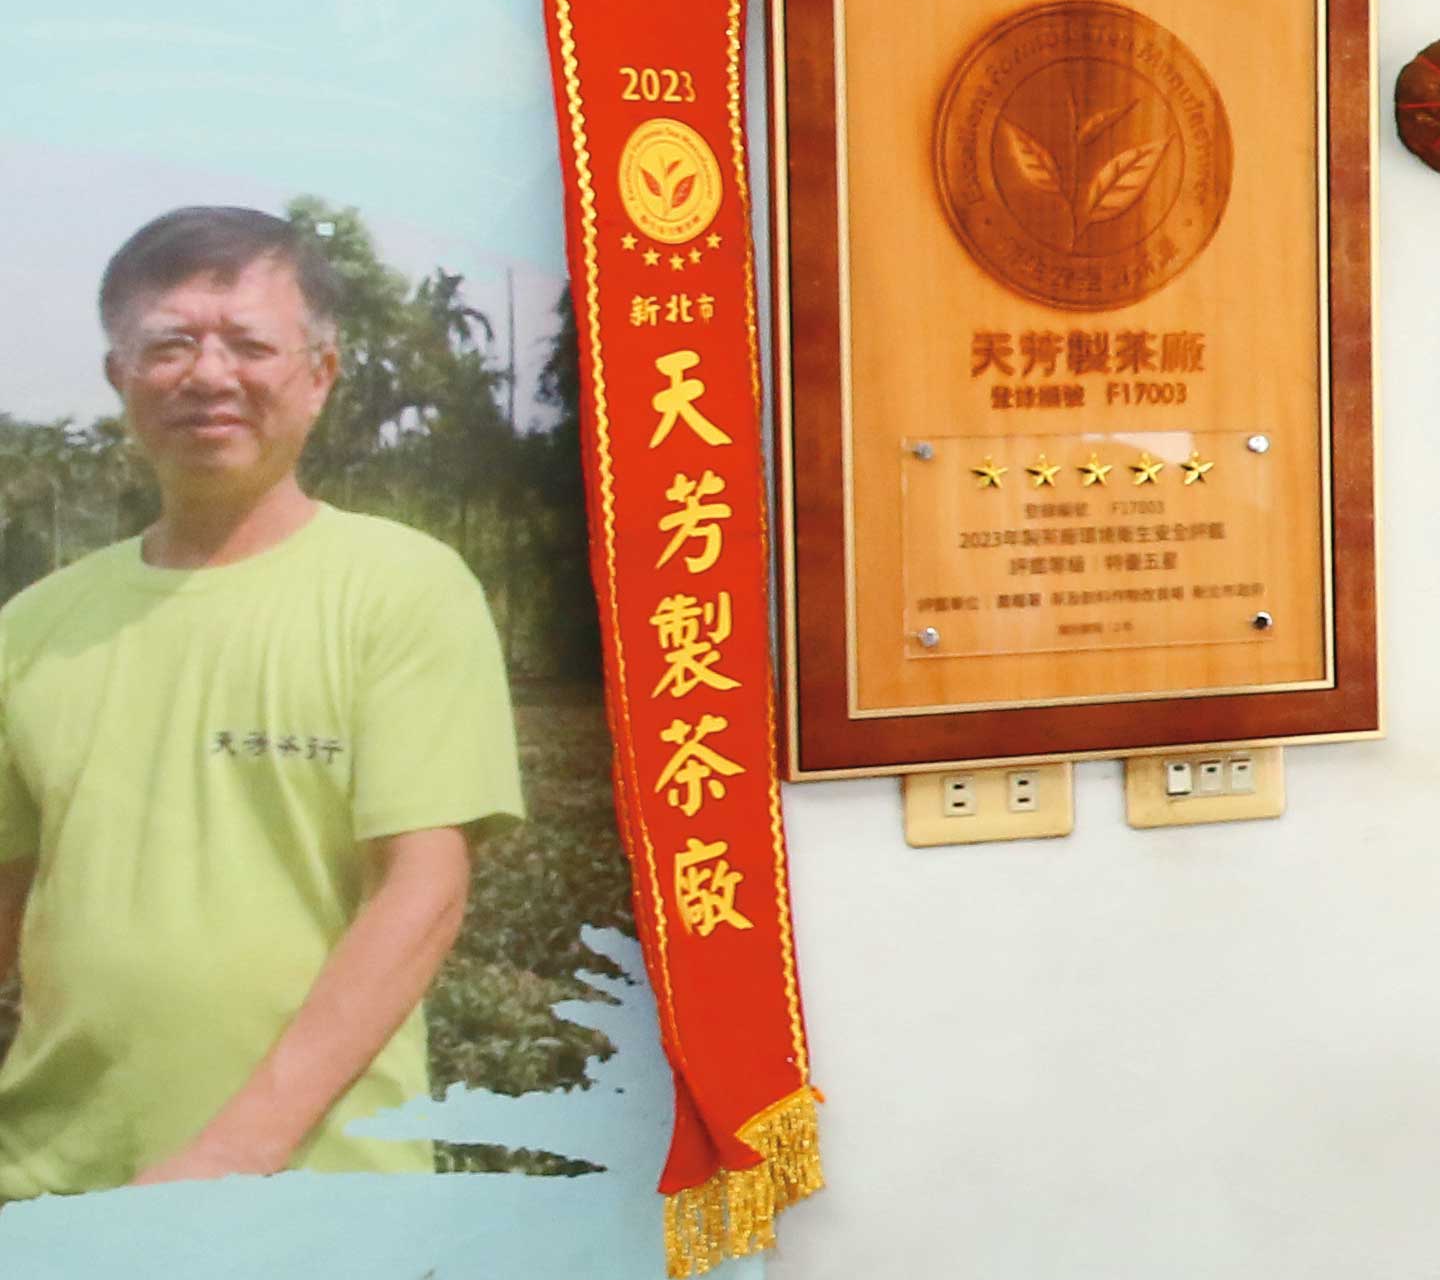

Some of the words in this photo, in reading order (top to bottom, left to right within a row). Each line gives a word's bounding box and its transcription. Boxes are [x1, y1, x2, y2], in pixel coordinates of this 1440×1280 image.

[628, 293, 717, 328] 新北市
[970, 330, 1206, 377] 天芳製茶廠
[1105, 382, 1188, 405] F17003
[647, 347, 756, 941] 天芳製茶廠
